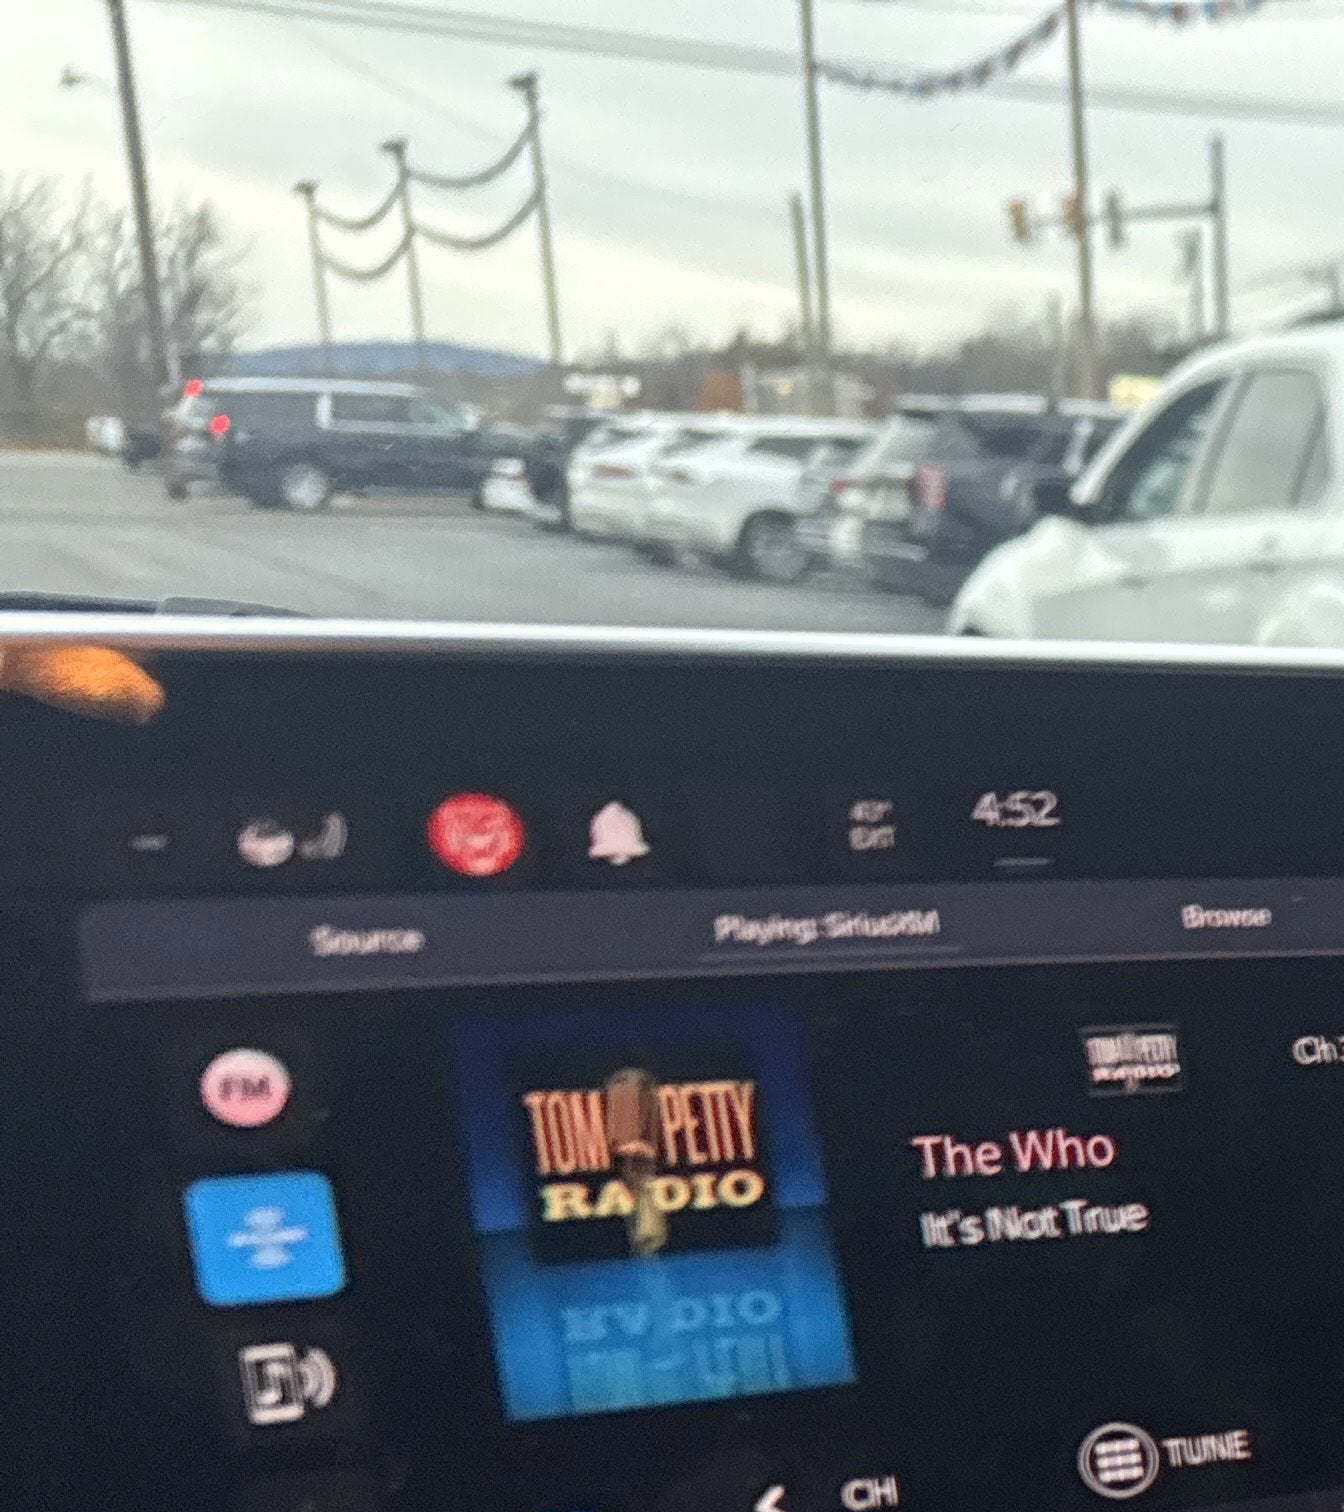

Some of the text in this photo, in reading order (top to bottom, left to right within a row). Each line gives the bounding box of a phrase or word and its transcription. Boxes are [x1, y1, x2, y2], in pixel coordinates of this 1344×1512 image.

[822, 907, 941, 940] SiriusXM
[1181, 902, 1272, 930] Browse
[309, 924, 426, 957] Source
[218, 1073, 271, 1101] FM
[523, 1079, 755, 1176] TOM PETTY
[913, 1127, 1116, 1180] The Who
[541, 1169, 766, 1222] RADIO
[921, 1197, 1149, 1248] It's Not True
[1162, 1431, 1252, 1467] TUNE
[841, 1476, 898, 1512] CH
